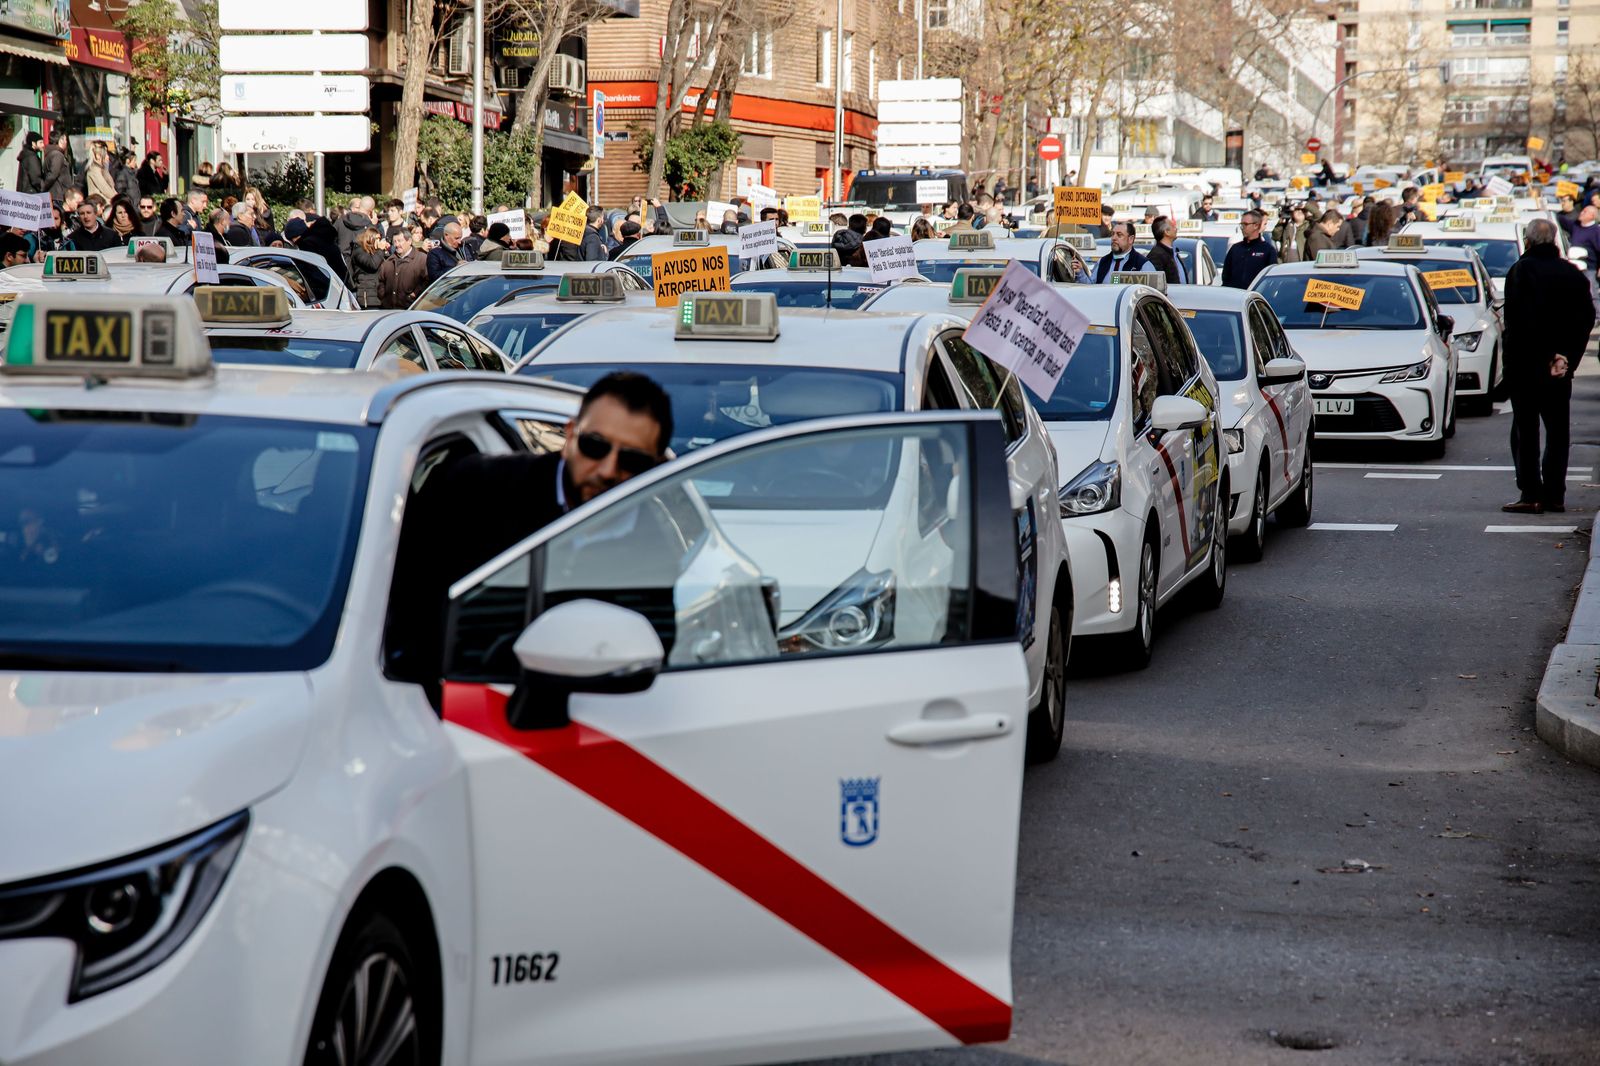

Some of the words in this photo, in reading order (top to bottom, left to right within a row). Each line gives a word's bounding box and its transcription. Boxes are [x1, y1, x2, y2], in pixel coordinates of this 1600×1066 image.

[1076, 191, 1098, 202] DICTADORA
[1056, 205, 1071, 216] CONTRA
[682, 232, 697, 241] TAXI
[960, 234, 978, 246] TAXI
[56, 258, 84, 272] TAXI
[510, 252, 528, 264] TAXI
[801, 254, 822, 266] TAXI
[663, 258, 698, 276] AYUSO
[702, 255, 724, 272] NOS
[573, 280, 600, 294] TAXI
[658, 276, 717, 298] ATROPELLA
[970, 278, 998, 295] TAX
[997, 280, 1017, 305] Ayuso
[1334, 286, 1360, 296] DICTADORA
[214, 294, 259, 313] TAXI
[697, 300, 742, 324] TAXI
[50, 315, 130, 358] TAXI
[1000, 318, 1012, 338] 50
[1010, 324, 1038, 358] licencias
[1032, 348, 1048, 366] por
[1326, 402, 1352, 413] LVJ
[490, 952, 560, 986] 11662
